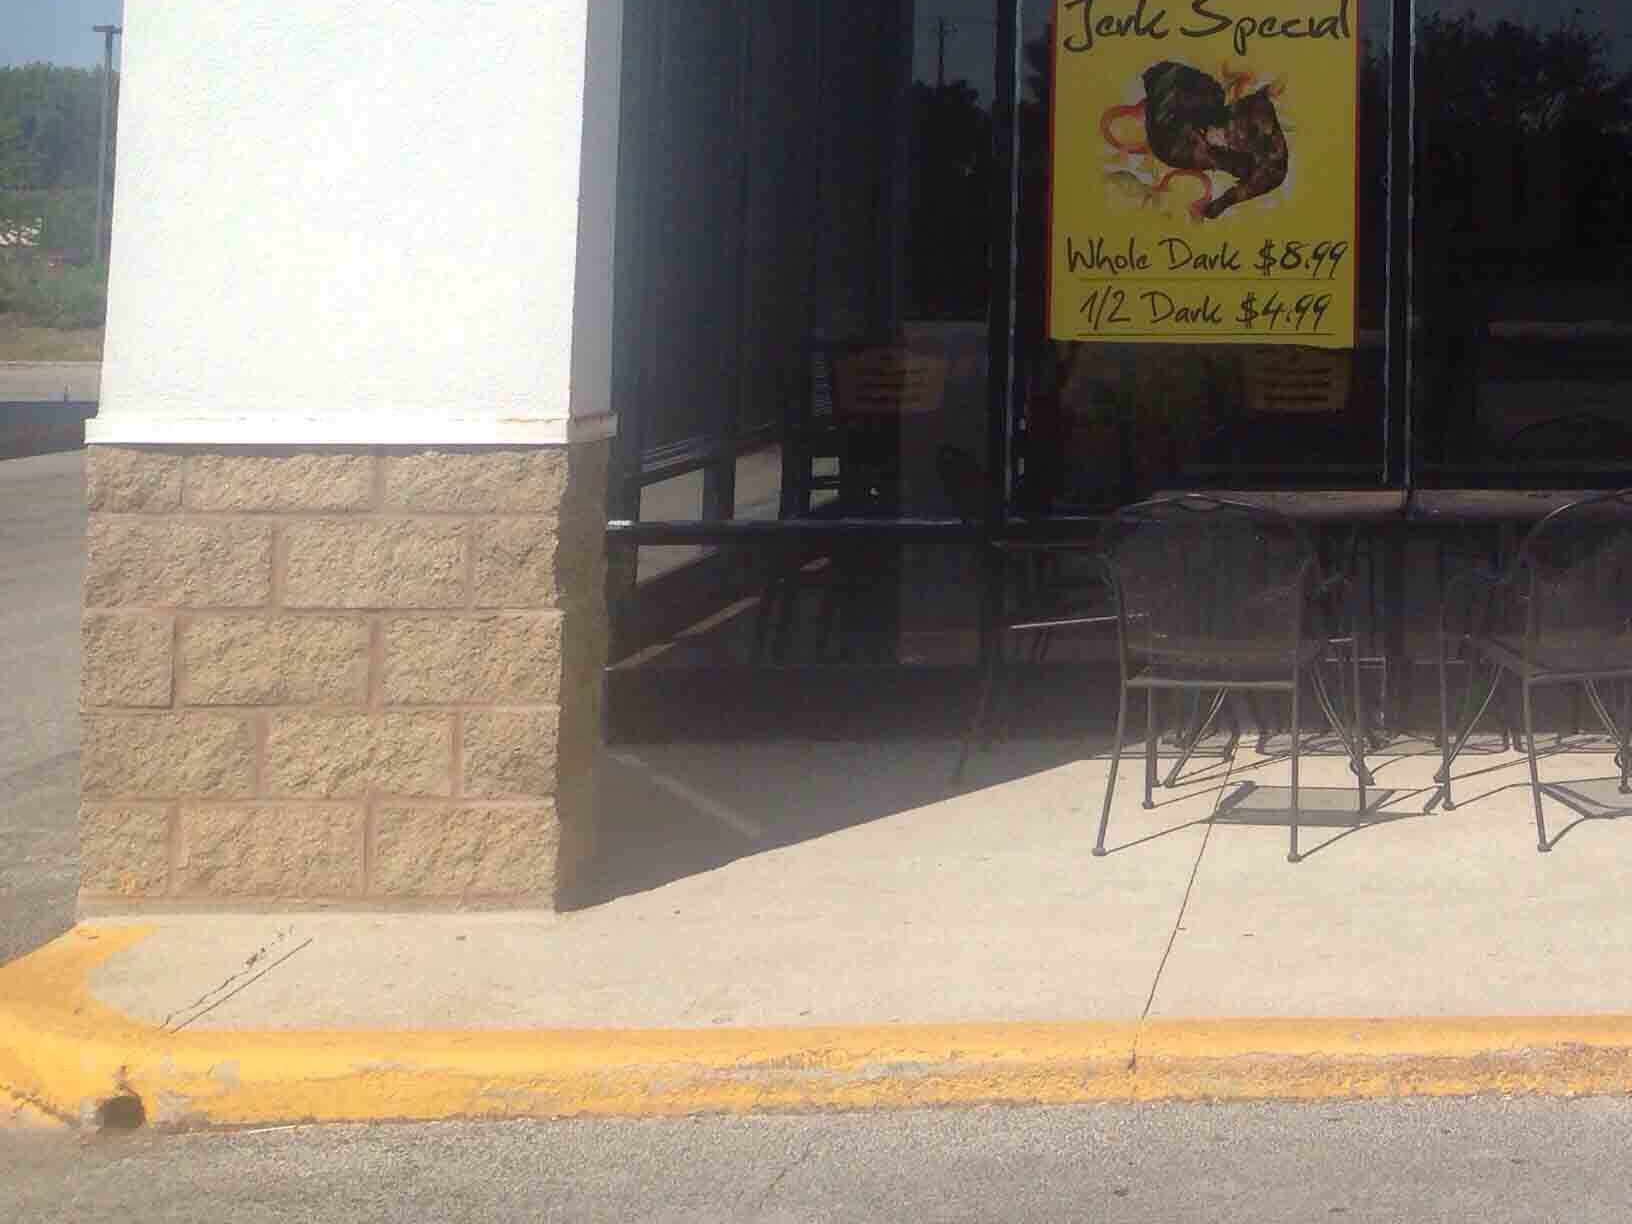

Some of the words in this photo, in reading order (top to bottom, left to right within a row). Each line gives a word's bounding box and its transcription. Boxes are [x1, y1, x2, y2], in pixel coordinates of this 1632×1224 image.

[1066, 236, 1150, 273] Whole
[1157, 238, 1241, 271] Dark
[1253, 238, 1348, 277] $8.99
[1079, 286, 1131, 329] 1/2
[1140, 290, 1222, 324] Dark
[1235, 291, 1329, 330] $4.99
